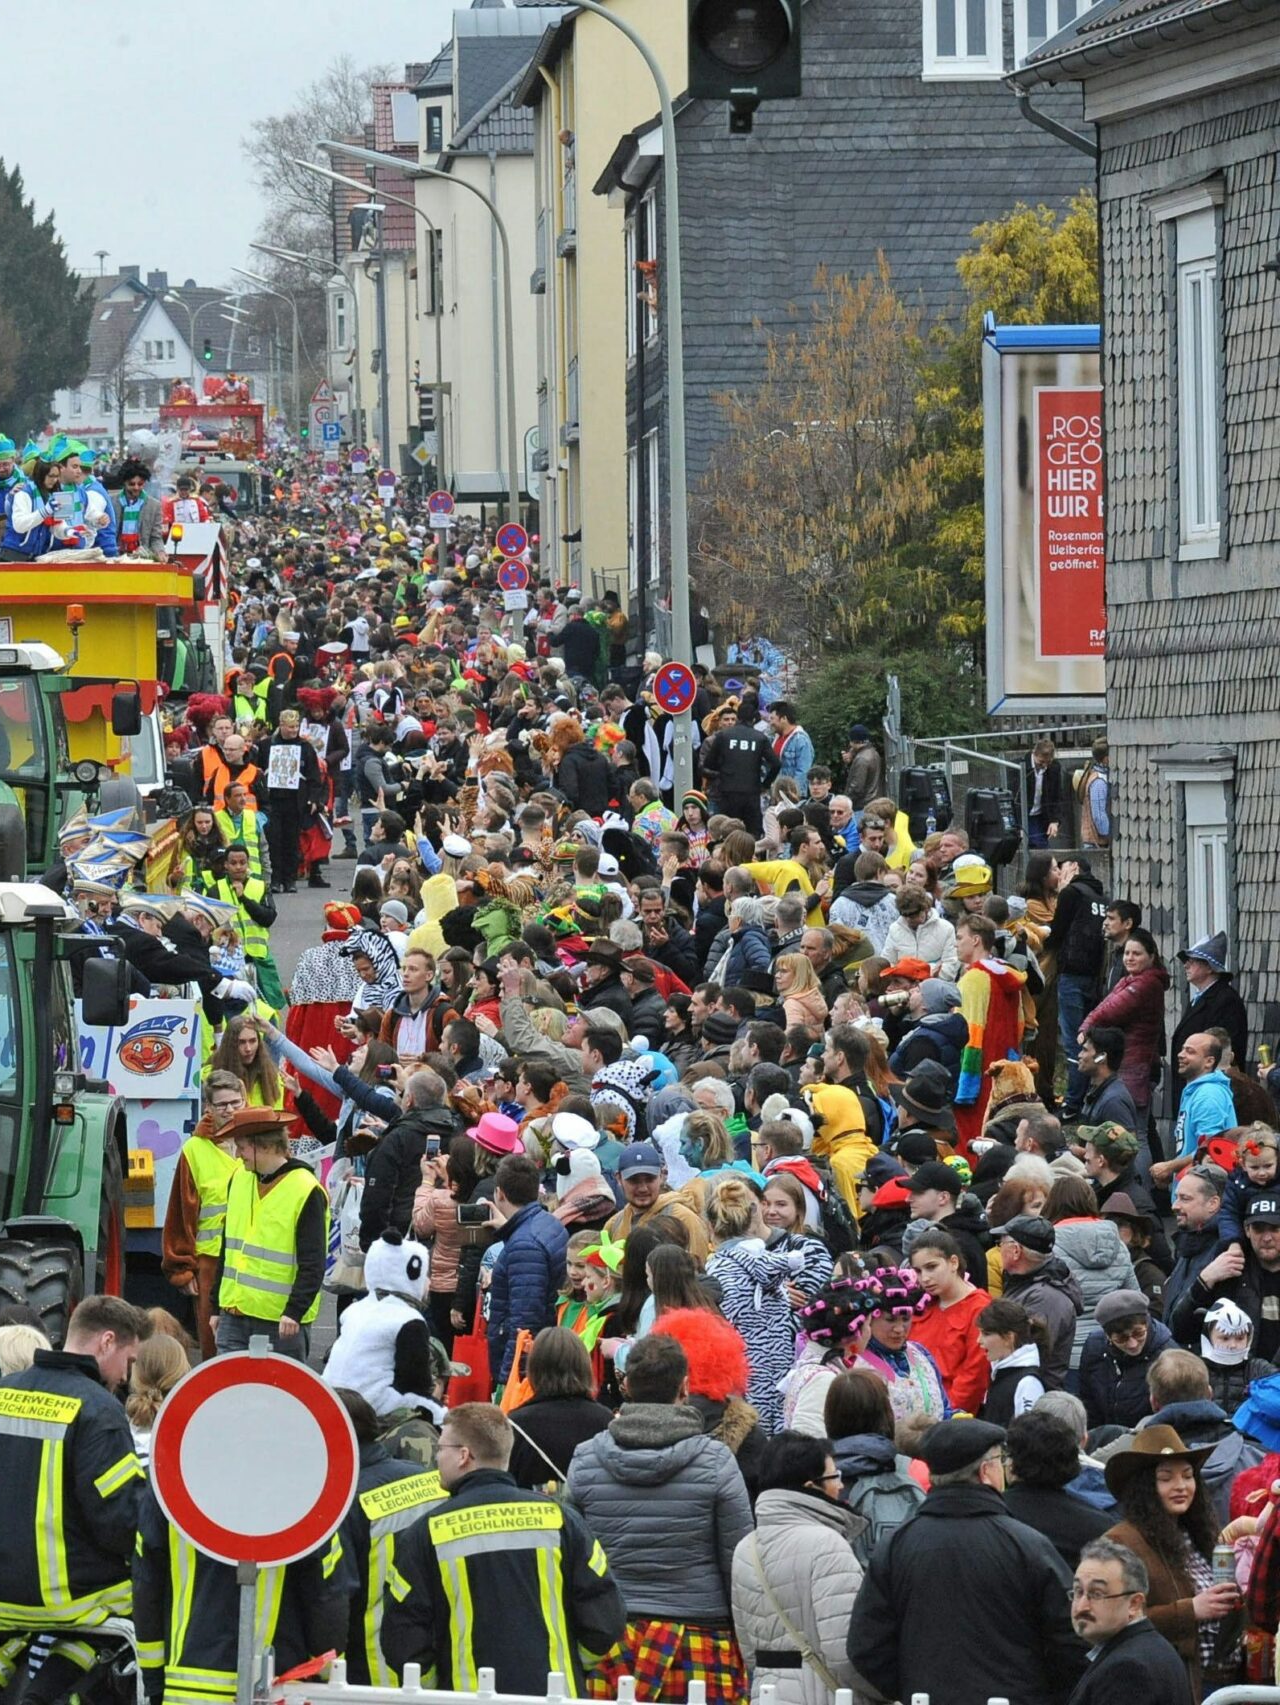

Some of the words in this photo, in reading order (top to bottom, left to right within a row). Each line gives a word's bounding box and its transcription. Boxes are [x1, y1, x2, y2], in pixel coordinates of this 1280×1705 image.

[1048, 469, 1096, 491] HIER
[1048, 496, 1089, 518] WIR
[1050, 560, 1099, 571] geöffnet.
[729, 739, 756, 751] FBI
[138, 1016, 179, 1030] ELK
[1251, 1201, 1276, 1214] FBI
[363, 1474, 441, 1506] FEUERWEHR
[379, 1487, 439, 1513] LEICHLINGEN
[434, 1506, 557, 1530] FEUERWEHR
[452, 1516, 543, 1537] LEICHLINGEN
